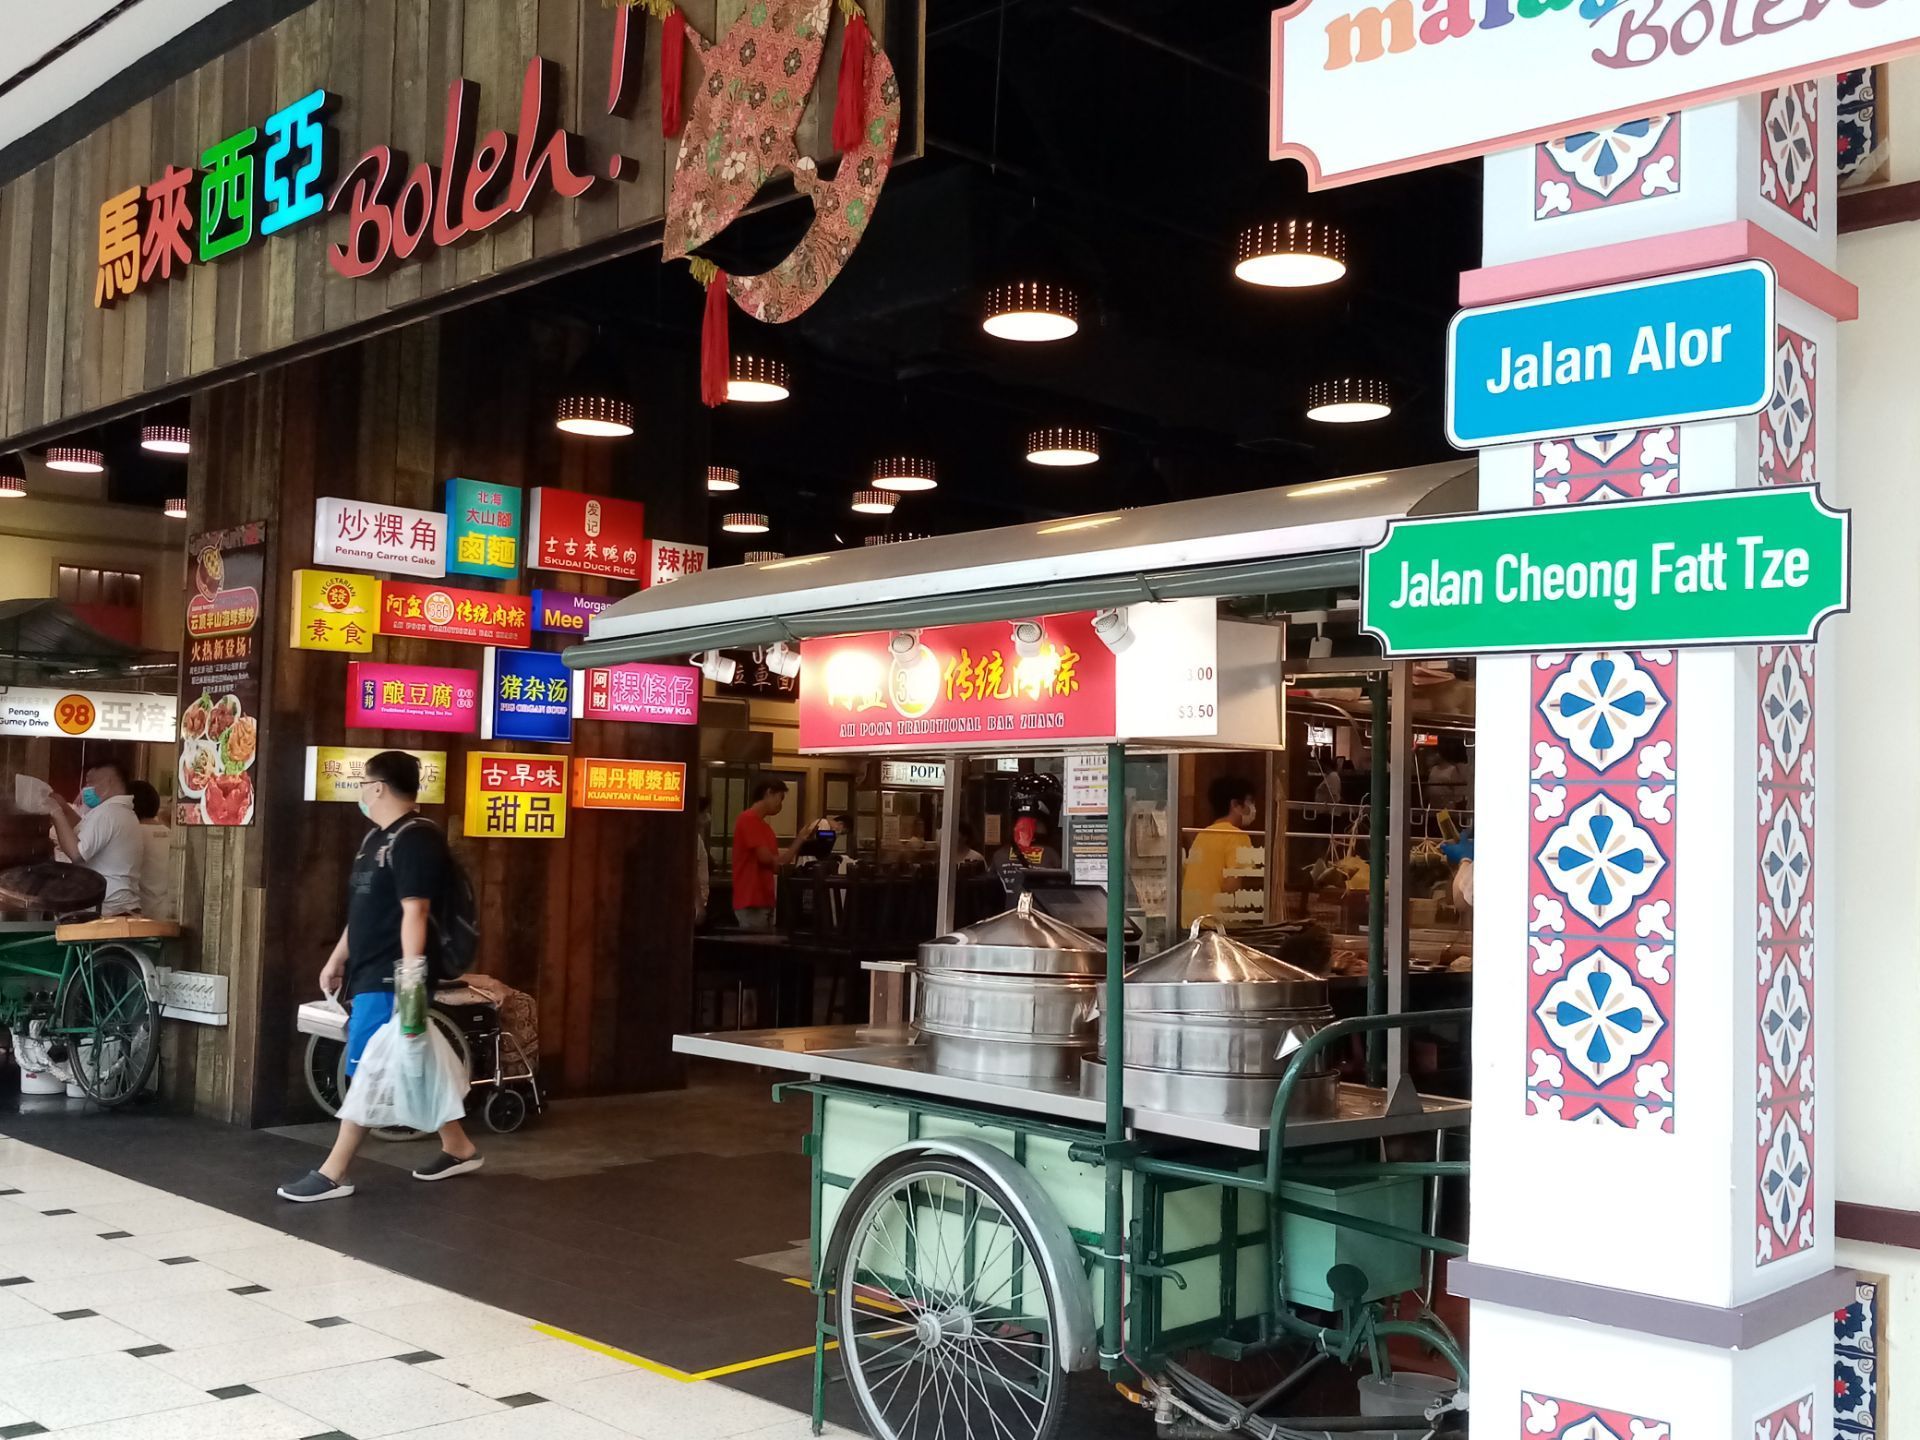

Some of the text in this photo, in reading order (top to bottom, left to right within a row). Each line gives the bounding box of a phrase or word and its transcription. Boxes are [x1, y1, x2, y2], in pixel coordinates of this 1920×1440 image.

[94, 88, 326, 309] 馬來西亞
[1486, 321, 1732, 395] Jalan Alor
[478, 490, 503, 506] 北海
[338, 507, 437, 552] 炒粿角
[335, 545, 436, 566] Penang Carrot Cake
[544, 556, 636, 576] SKUDAI DUCK RICE
[658, 545, 704, 575] 辣椒
[1388, 535, 1810, 611] Jalan Cheong Fatt Tze
[320, 577, 357, 598] VEGETARIAN
[306, 618, 367, 646] 素食
[545, 609, 584, 629] Mee
[382, 680, 454, 709] 酿豆腐
[501, 674, 569, 703] 猪杂汤
[593, 672, 608, 709] 阿財
[8, 707, 40, 718] Penang
[28, 718, 50, 727] Drive
[60, 703, 90, 726] 98
[612, 703, 693, 717] KWAY TEOW KIA
[1178, 704, 1214, 719] $3.50
[839, 712, 1065, 738] AH POON TRADITIONAL BAK ZHANG
[483, 762, 561, 788] 古早味
[587, 791, 632, 801] KUANTAN
[653, 793, 681, 802] Lemak
[486, 795, 555, 832] 甜品
